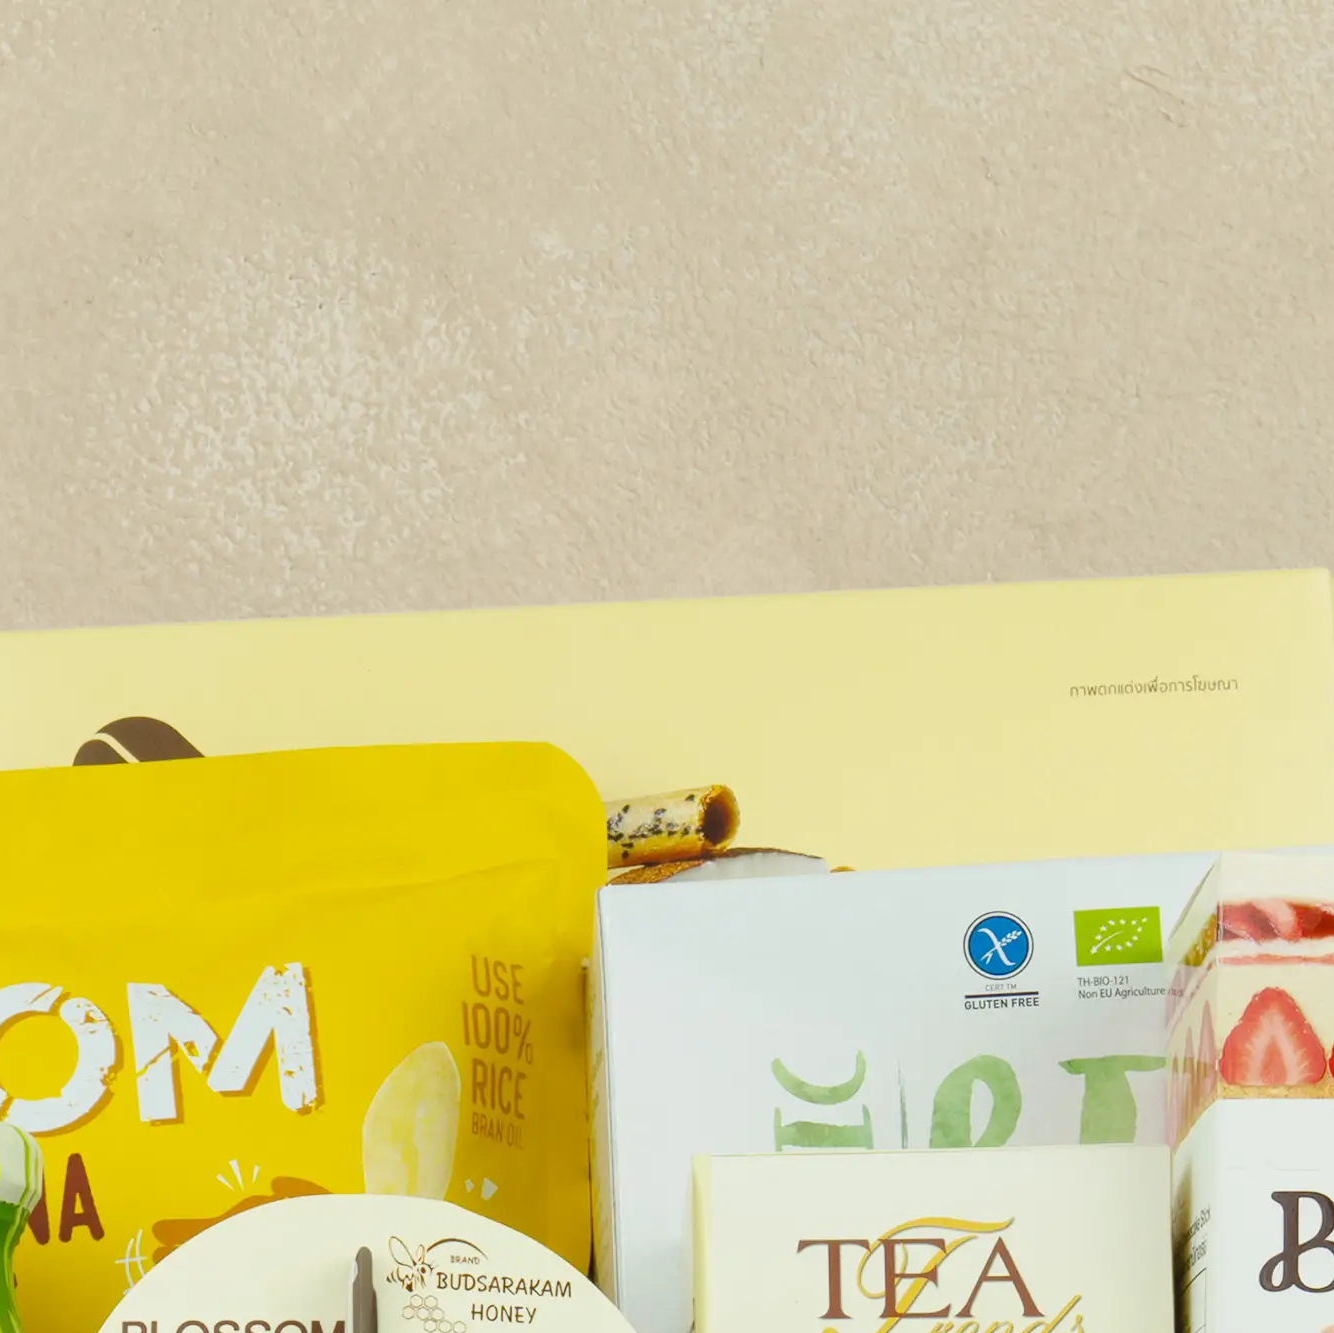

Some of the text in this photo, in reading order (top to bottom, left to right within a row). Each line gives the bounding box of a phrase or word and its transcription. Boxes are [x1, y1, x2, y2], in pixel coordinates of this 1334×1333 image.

[471, 955, 524, 1005] USE
[1077, 976, 1129, 987] TH-BIO-121
[1078, 989, 1098, 999] Non
[1100, 988, 1112, 999] EU
[1115, 986, 1166, 1000] Agriculture
[964, 997, 1040, 1011] GLUTEN FREE
[462, 1001, 533, 1065] 100%
[472, 1058, 527, 1120] RICE
[472, 1111, 503, 1143] BRAN
[450, 1255, 480, 1265] BRAND
[436, 1272, 572, 1298] BUDSARAKAM
[796, 1236, 1046, 1320] TEA
[471, 1303, 537, 1324] HONEY
